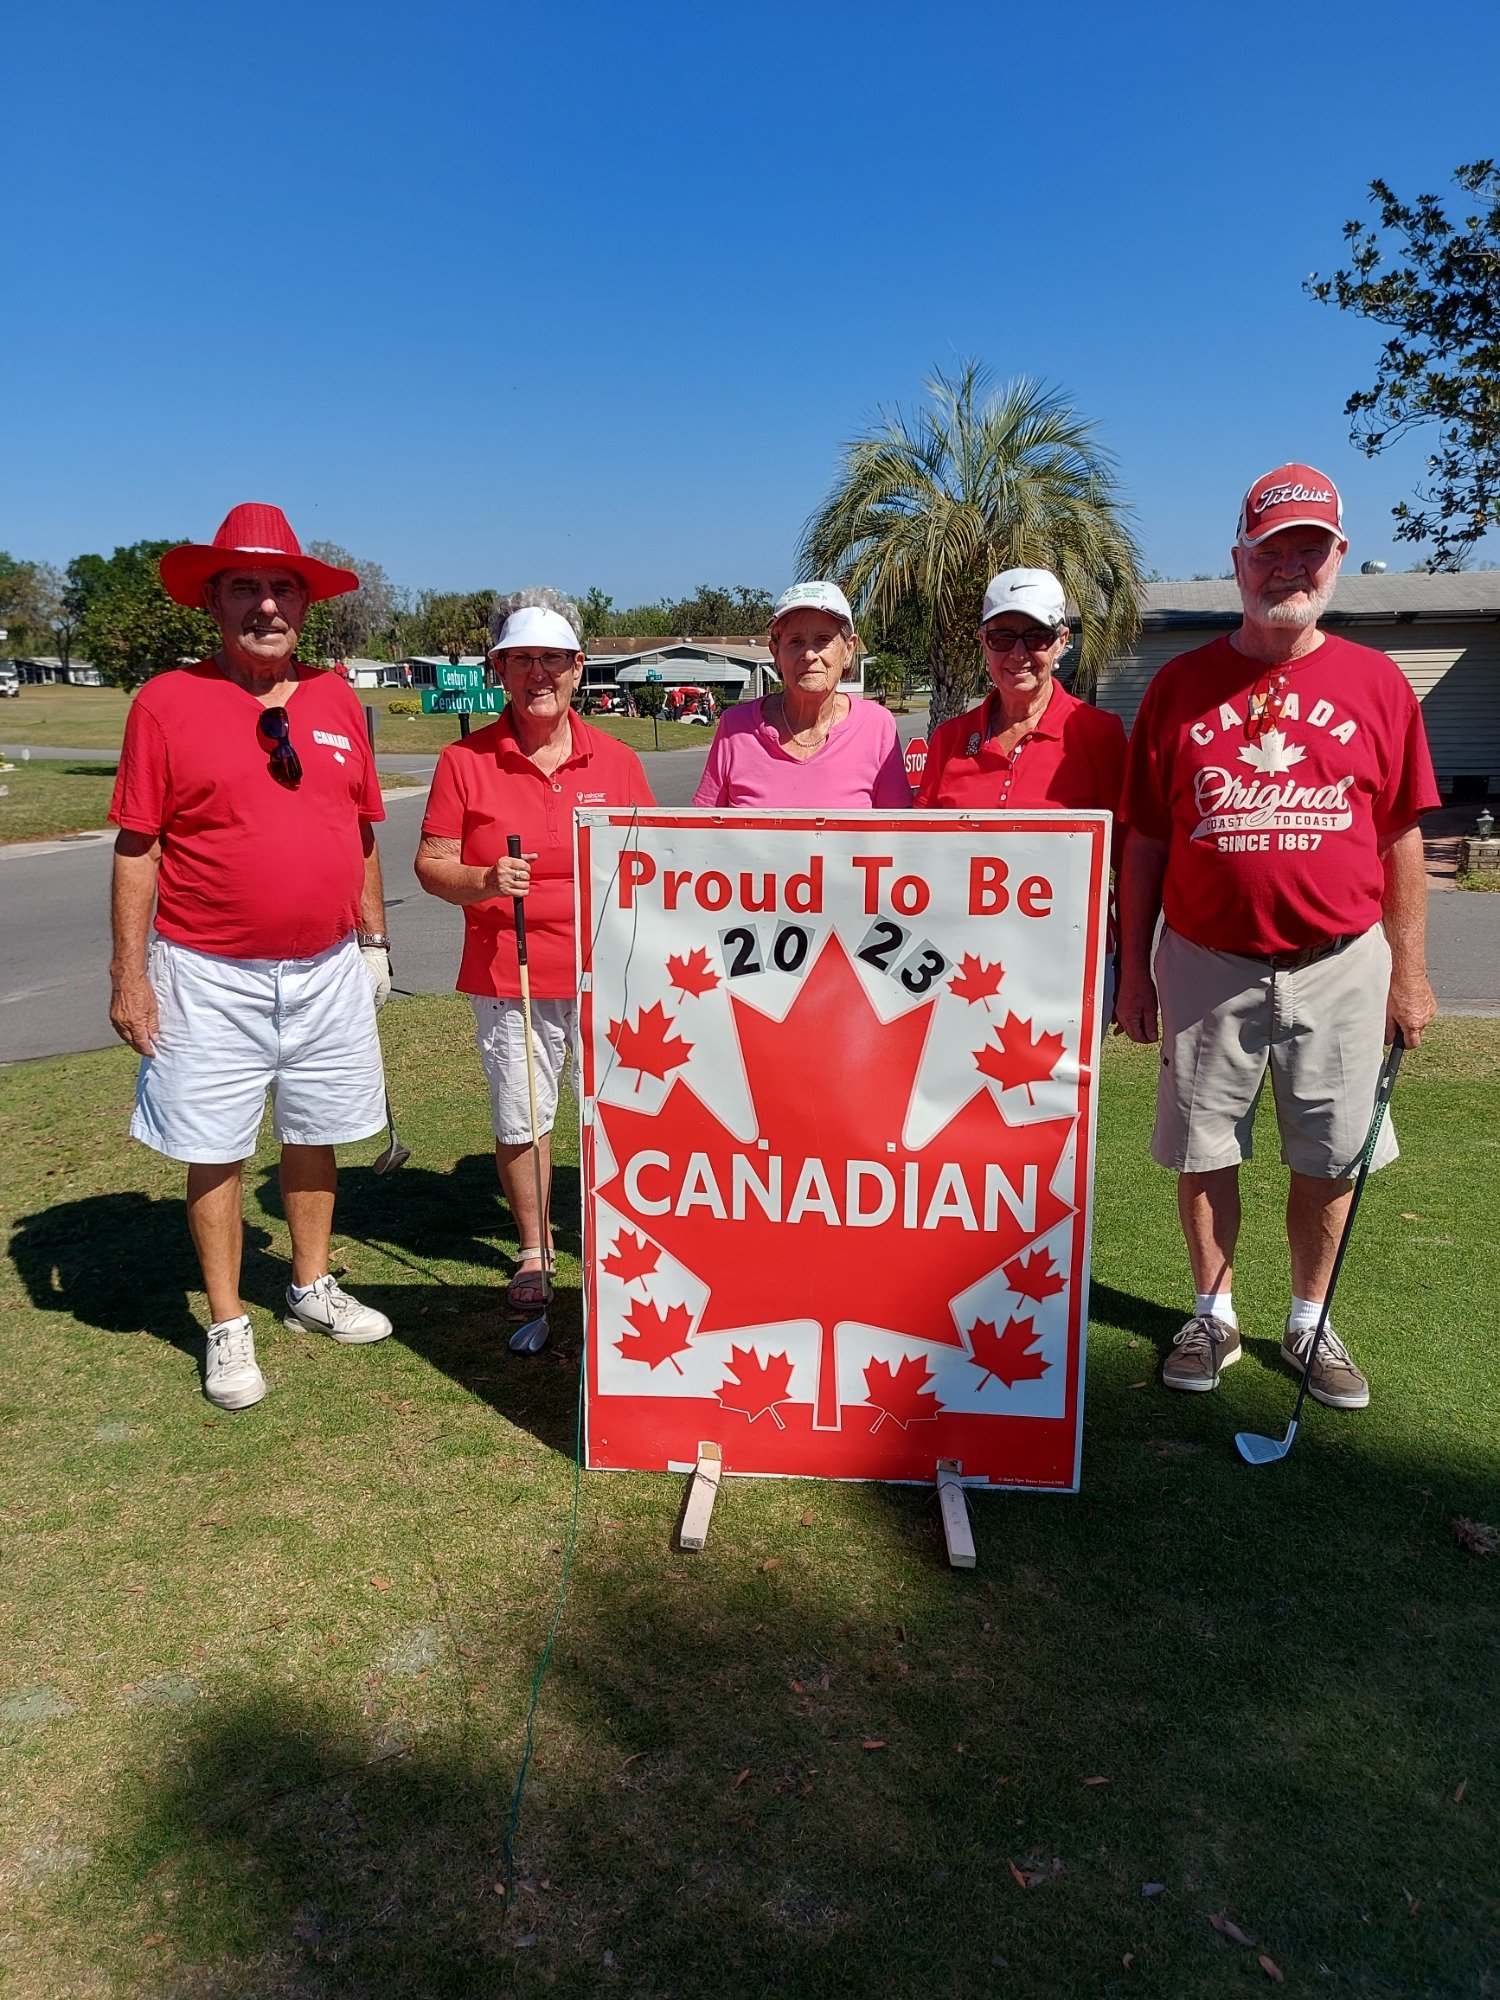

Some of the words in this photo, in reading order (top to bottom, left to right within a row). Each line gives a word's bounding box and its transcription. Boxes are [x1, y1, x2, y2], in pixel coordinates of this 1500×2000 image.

[1254, 482, 1333, 514] Titleist
[442, 669, 467, 689] Century
[469, 670, 478, 687] DR
[431, 694, 474, 713] Century
[479, 692, 495, 709] LN
[1190, 693, 1357, 746] CANADA
[1194, 766, 1355, 827] Original
[1206, 817, 1244, 830] COAST
[1274, 815, 1291, 826] TO
[1295, 816, 1338, 827] COAST
[1217, 834, 1270, 853] SINCE
[1278, 834, 1322, 851] 1867
[617, 850, 824, 914] Proud
[852, 856, 931, 917] To
[967, 856, 1054, 918] Be
[623, 1149, 1039, 1234] CANADIAN
